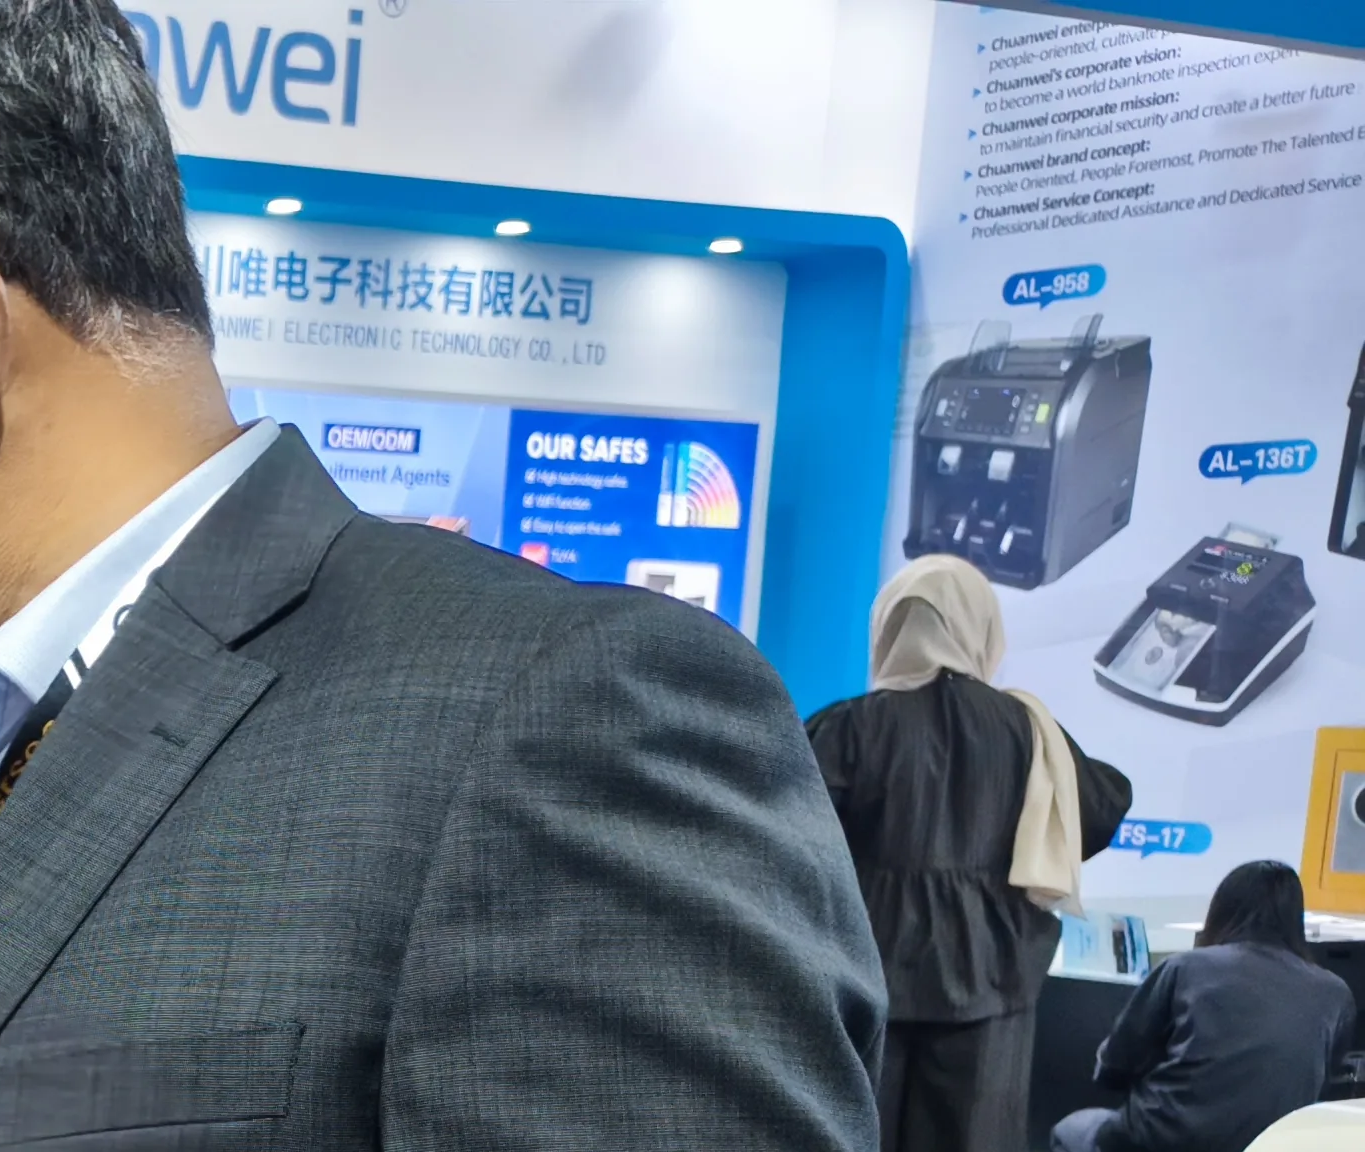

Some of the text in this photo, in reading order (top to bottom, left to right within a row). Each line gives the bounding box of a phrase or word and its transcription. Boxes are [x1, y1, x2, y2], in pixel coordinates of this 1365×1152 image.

[989, 29, 1159, 73] people-oriented, cultivate
[992, 25, 1058, 52] Chuanwei
[984, 100, 997, 114] to
[1000, 89, 1053, 112] become
[1055, 88, 1064, 101] a
[1067, 80, 1106, 99] world
[1109, 65, 1175, 91] banknote
[1177, 54, 1251, 78] inspection
[986, 46, 1182, 94] Chuanwei's corporate vision:
[980, 82, 1356, 155] to maintain financial security and create a better future
[982, 91, 1180, 136] Chuanwei corporate mission:
[975, 179, 1018, 198] People
[1081, 163, 1126, 182] People
[1128, 152, 1195, 175] Foremost,
[1198, 145, 1258, 165] Promote
[1260, 138, 1287, 155] The
[1290, 126, 1355, 150] Talented
[978, 139, 1151, 179] Chuanwei brand concept:
[971, 173, 1362, 240] Professional Dedicated Assistance and Dedicated Service
[973, 182, 1155, 221] Chuanwei Service Concept:
[1013, 271, 1089, 300] AL-958
[284, 320, 402, 351] ELECTRONIC
[410, 330, 522, 359] TECHNOLOGY
[328, 425, 416, 453] OEM/ODM
[527, 431, 648, 465] OUR SAFES
[391, 465, 451, 490] Agents
[1208, 444, 1311, 474] AL-136T
[1119, 826, 1186, 847] FS-17
